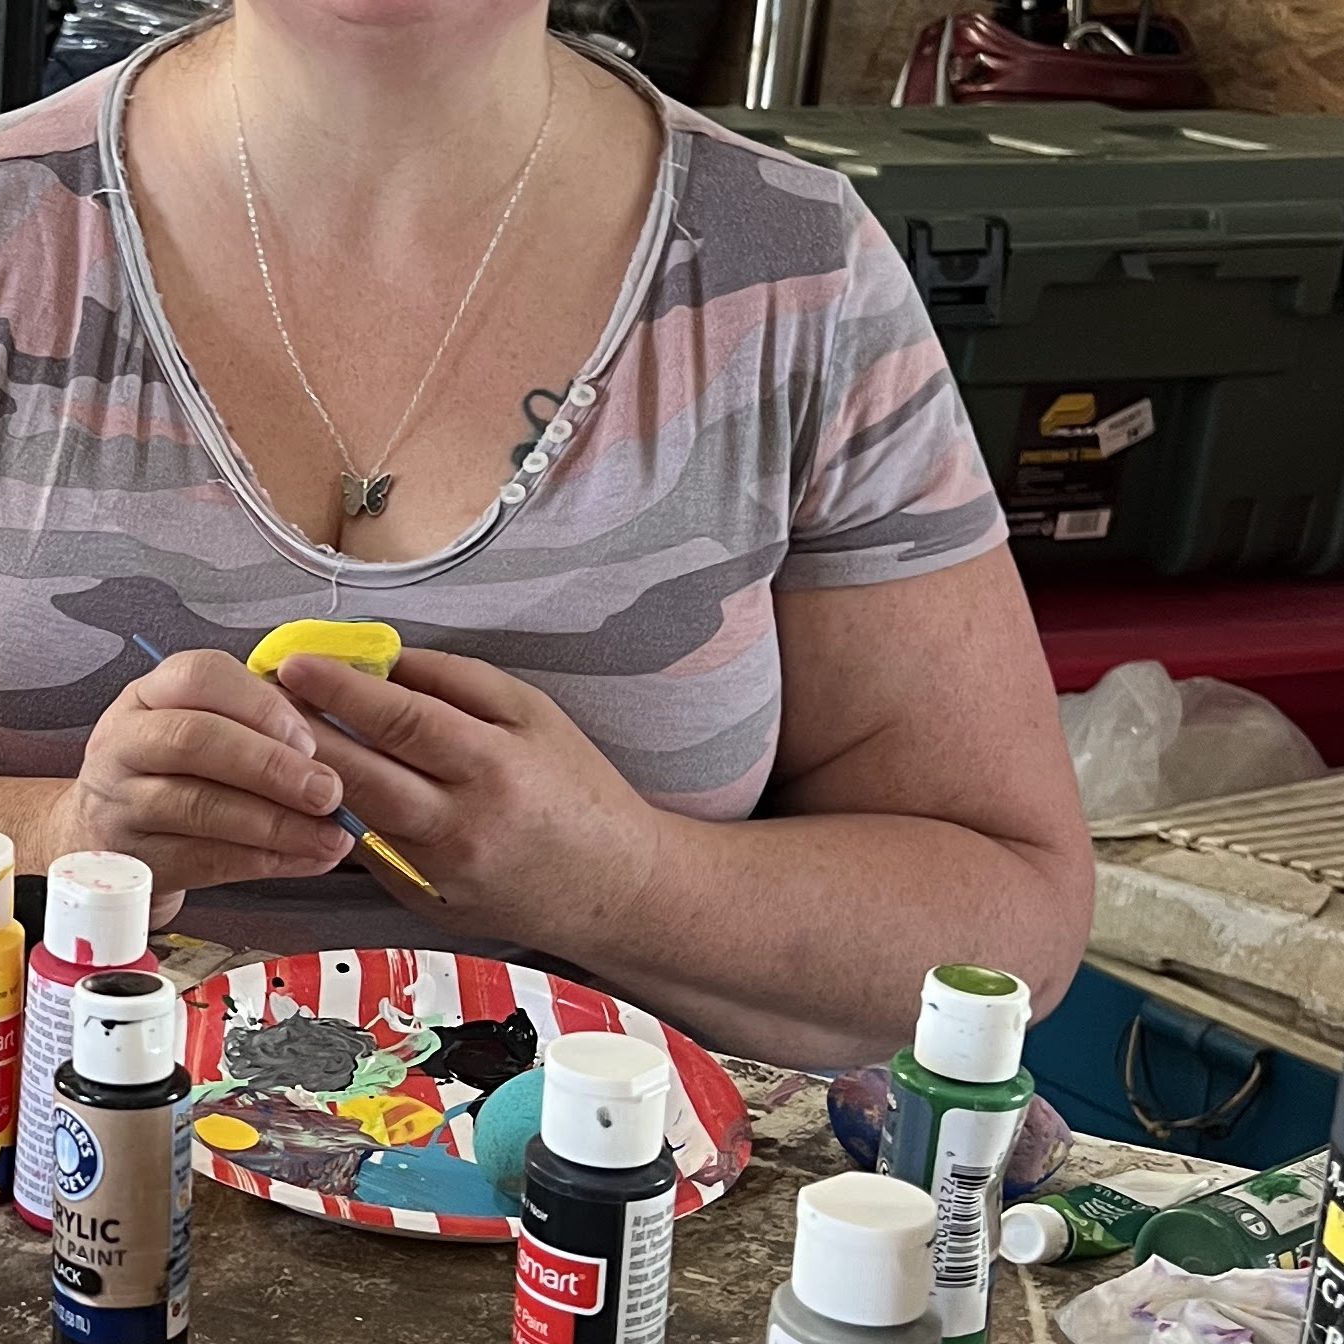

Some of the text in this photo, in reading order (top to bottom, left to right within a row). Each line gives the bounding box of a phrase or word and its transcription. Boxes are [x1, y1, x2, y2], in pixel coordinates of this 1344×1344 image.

[55, 1202, 122, 1245] RYLIC
[67, 1238, 127, 1267] PAINT
[56, 1261, 82, 1287] ACK
[521, 1307, 549, 1337] Paint
